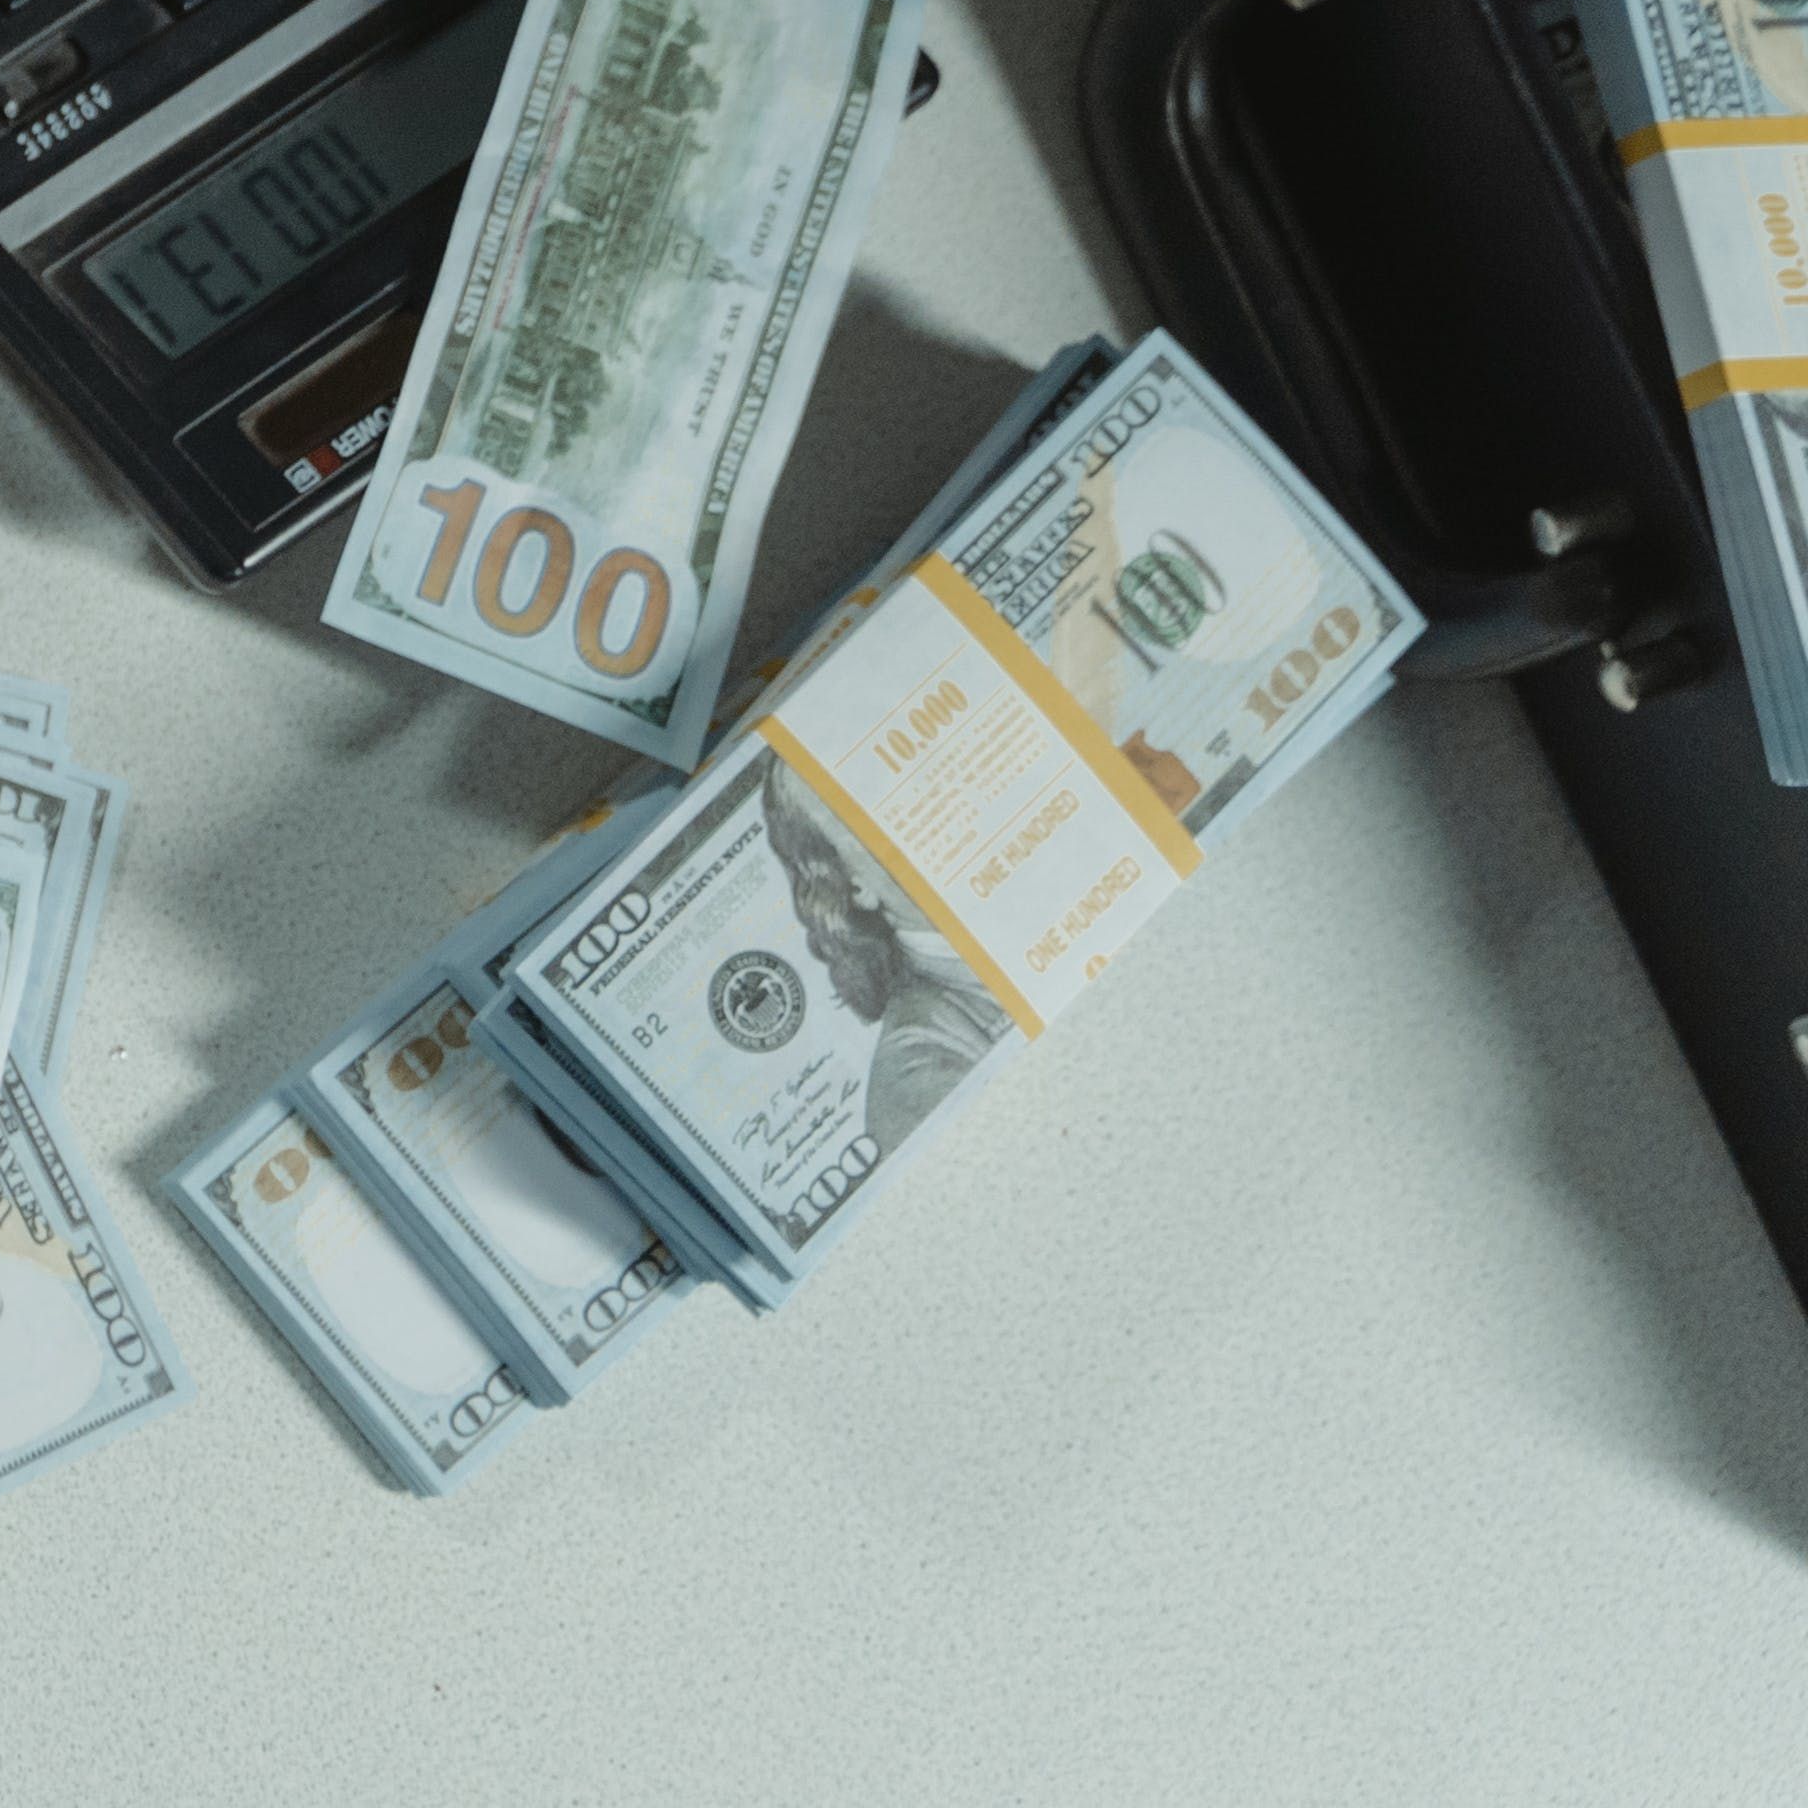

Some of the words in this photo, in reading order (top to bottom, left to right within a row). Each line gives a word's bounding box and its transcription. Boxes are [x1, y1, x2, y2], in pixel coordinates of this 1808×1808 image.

[771, 165, 790, 200] IN
[749, 206, 777, 259] GOD
[724, 302, 746, 346] WE
[687, 354, 730, 438] TRUST
[1073, 385, 1163, 479] 100
[417, 479, 670, 677] 100
[1089, 529, 1227, 675] 100
[1244, 605, 1361, 736] 100
[874, 679, 969, 776] 10.000
[969, 853, 1013, 899] ONE
[1007, 788, 1081, 868] HUNDRED
[559, 890, 651, 989] 100
[590, 931, 657, 997] FEDERAL
[657, 869, 725, 935] RESERVE
[721, 821, 765, 873] NOTE
[1024, 925, 1068, 974] ONE
[1062, 855, 1142, 941] HUNDRED
[631, 1012, 669, 1050] B2
[786, 1133, 880, 1229] 100
[68, 1242, 146, 1366] 100
